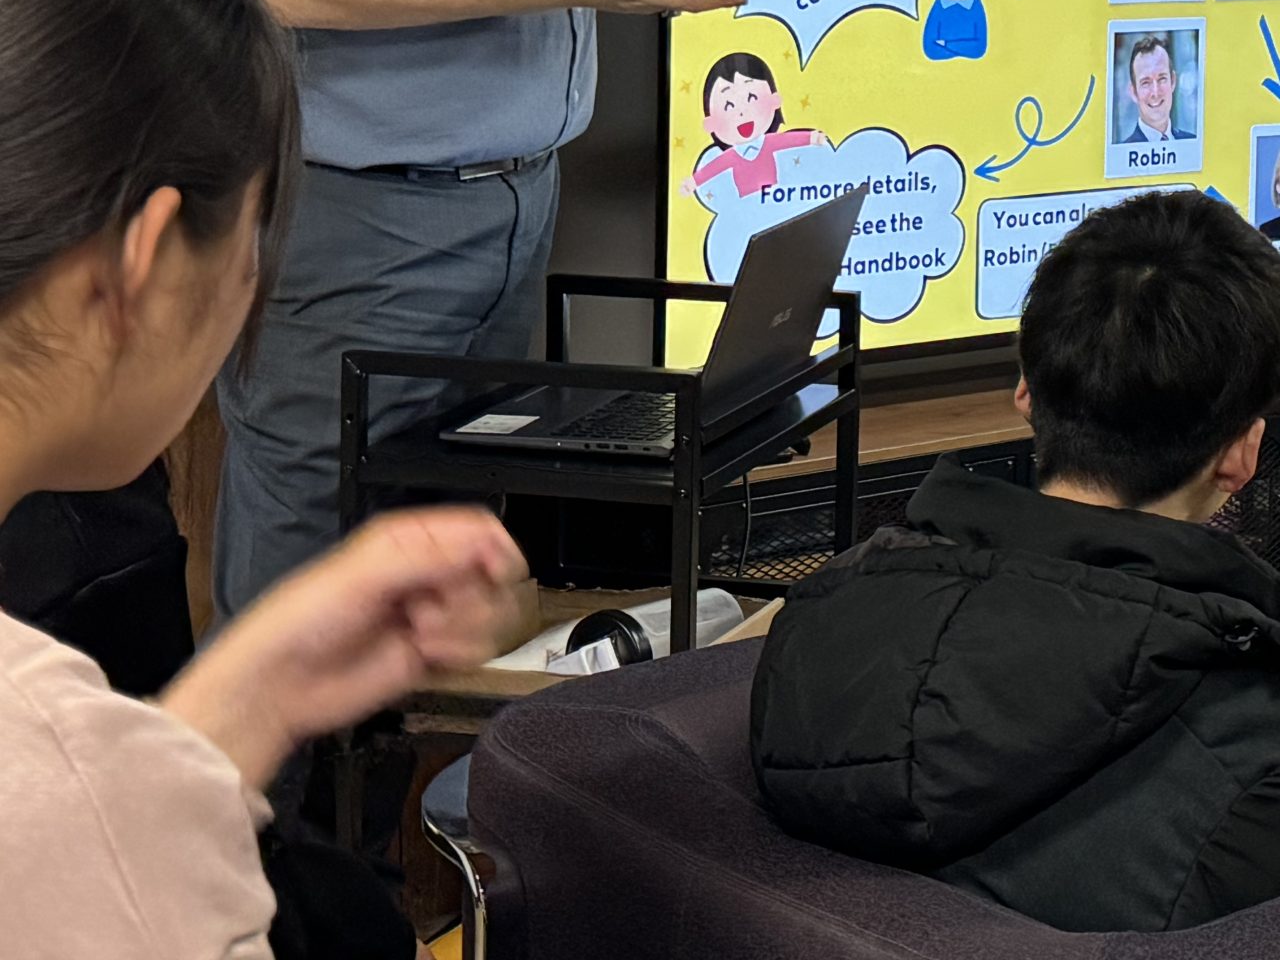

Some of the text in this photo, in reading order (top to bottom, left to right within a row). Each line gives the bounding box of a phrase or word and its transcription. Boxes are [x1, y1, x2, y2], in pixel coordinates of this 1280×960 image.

[1128, 147, 1177, 167] Robin
[760, 184, 796, 204] For
[800, 182, 854, 200] more
[851, 212, 923, 235] see the
[993, 211, 1029, 229] You
[1032, 209, 1065, 225] can
[841, 248, 946, 276] Handbook
[984, 244, 1037, 267] Robin
